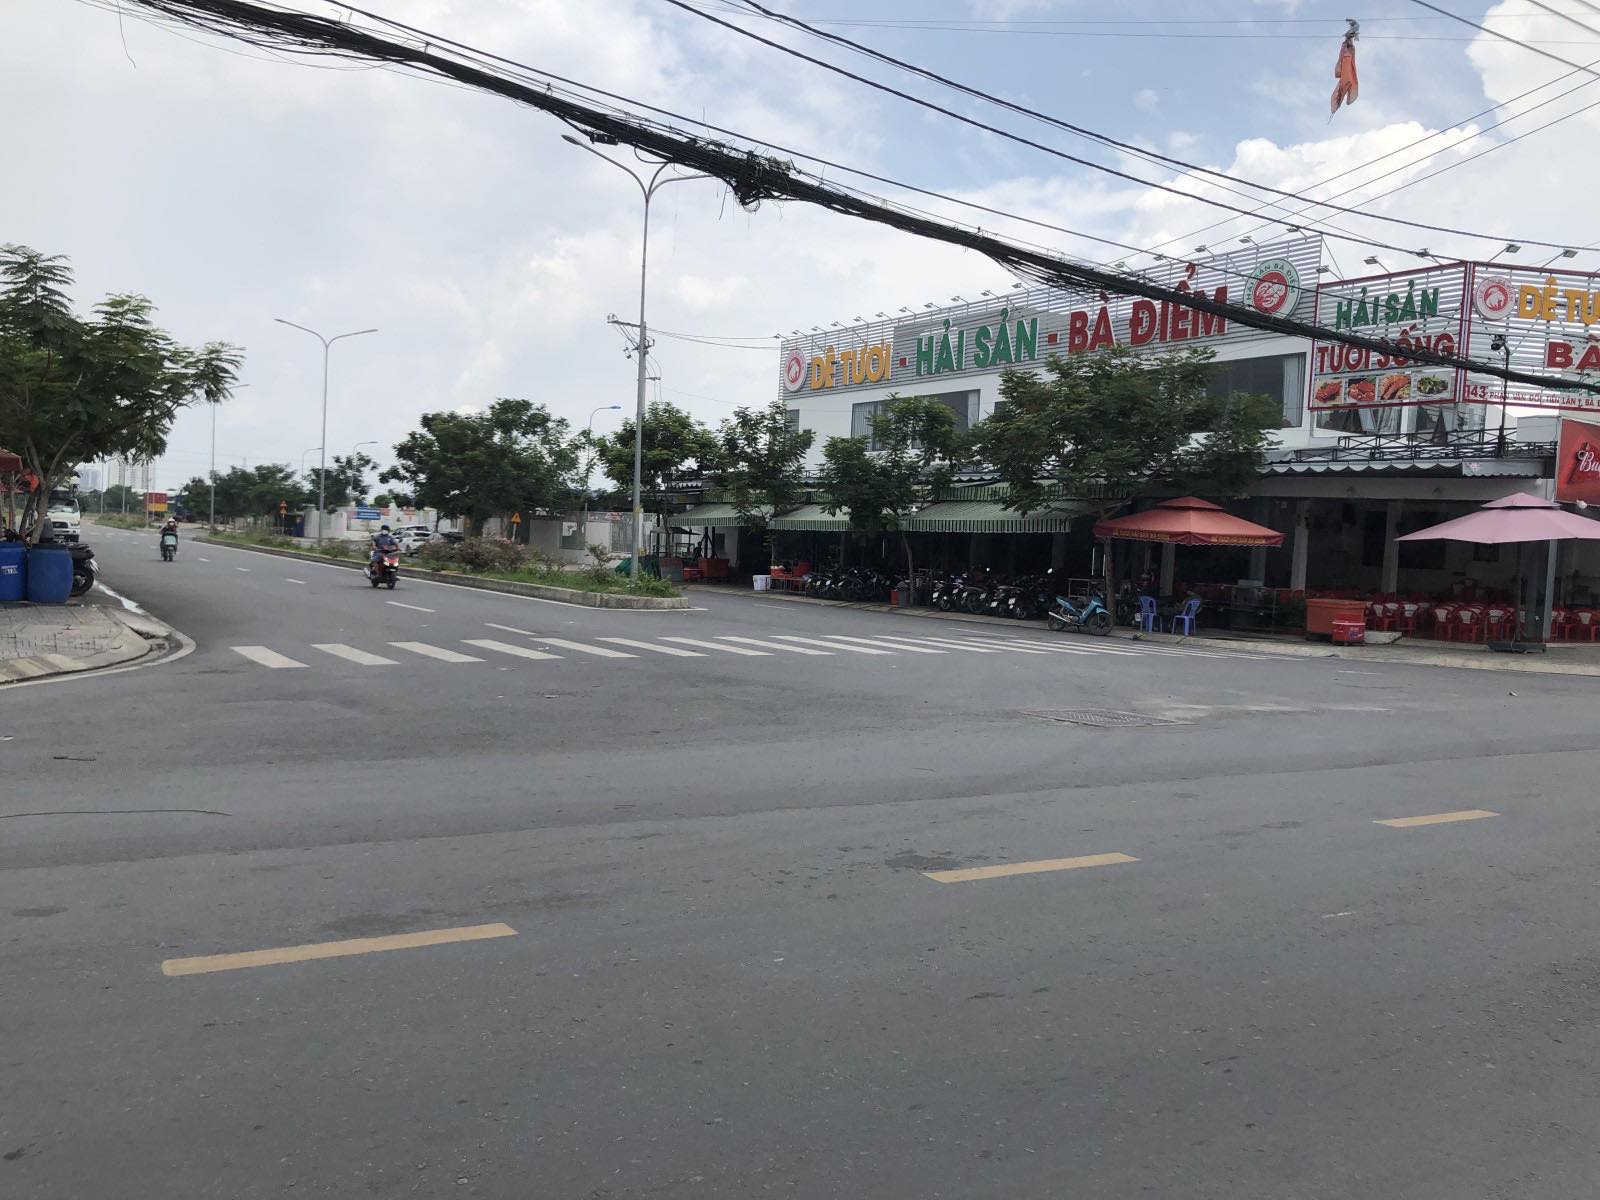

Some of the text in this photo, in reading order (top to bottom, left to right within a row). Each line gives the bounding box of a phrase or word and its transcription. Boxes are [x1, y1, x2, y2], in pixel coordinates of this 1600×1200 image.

[1335, 287, 1380, 329] HẢI
[1384, 279, 1440, 323] SẢN
[1518, 275, 1559, 321] DÊ
[810, 344, 836, 391] DÊ
[840, 339, 893, 386] TƯƠI
[915, 318, 967, 377] HẢI
[974, 307, 1040, 368] SẢN
[1068, 291, 1116, 354] BÀ
[1465, 384, 1487, 400] 143
